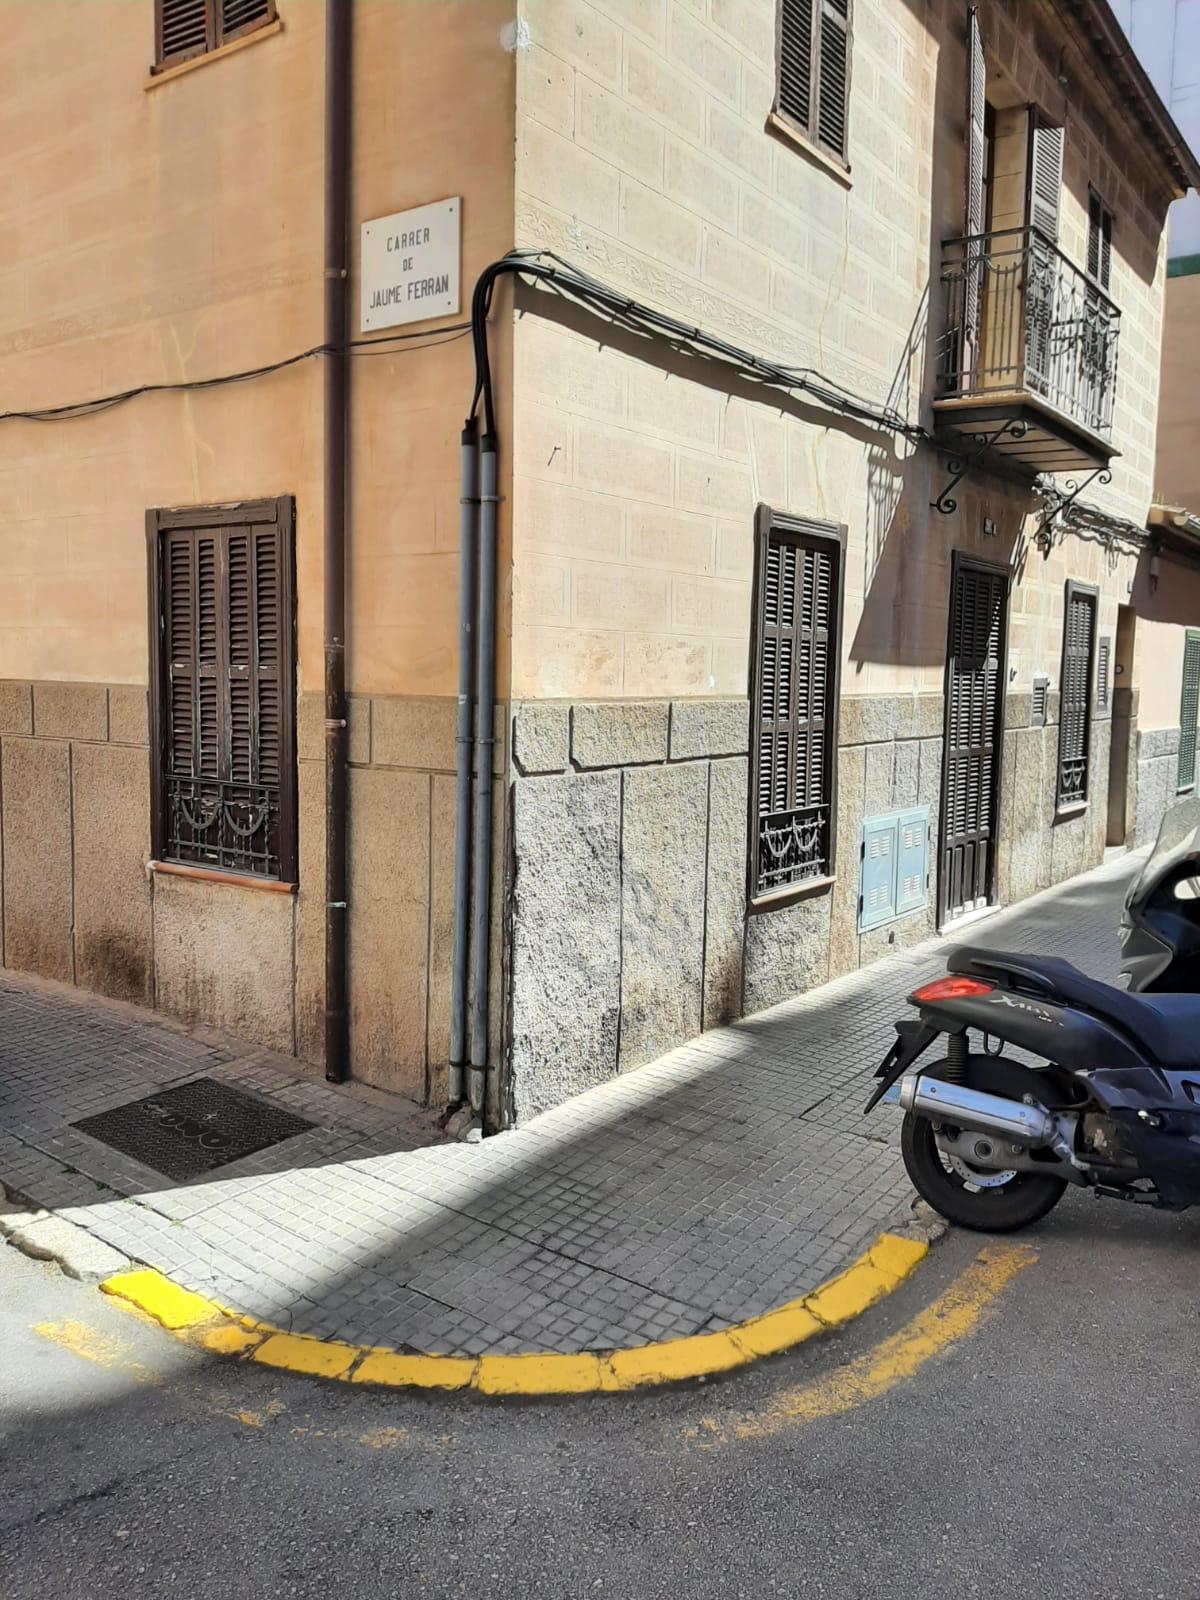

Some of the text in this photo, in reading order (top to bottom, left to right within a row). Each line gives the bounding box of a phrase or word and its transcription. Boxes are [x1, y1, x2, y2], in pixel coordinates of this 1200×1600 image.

[386, 227, 430, 253] CARRER
[402, 257, 414, 272] DE
[369, 273, 449, 309] JAUME FERRAN
